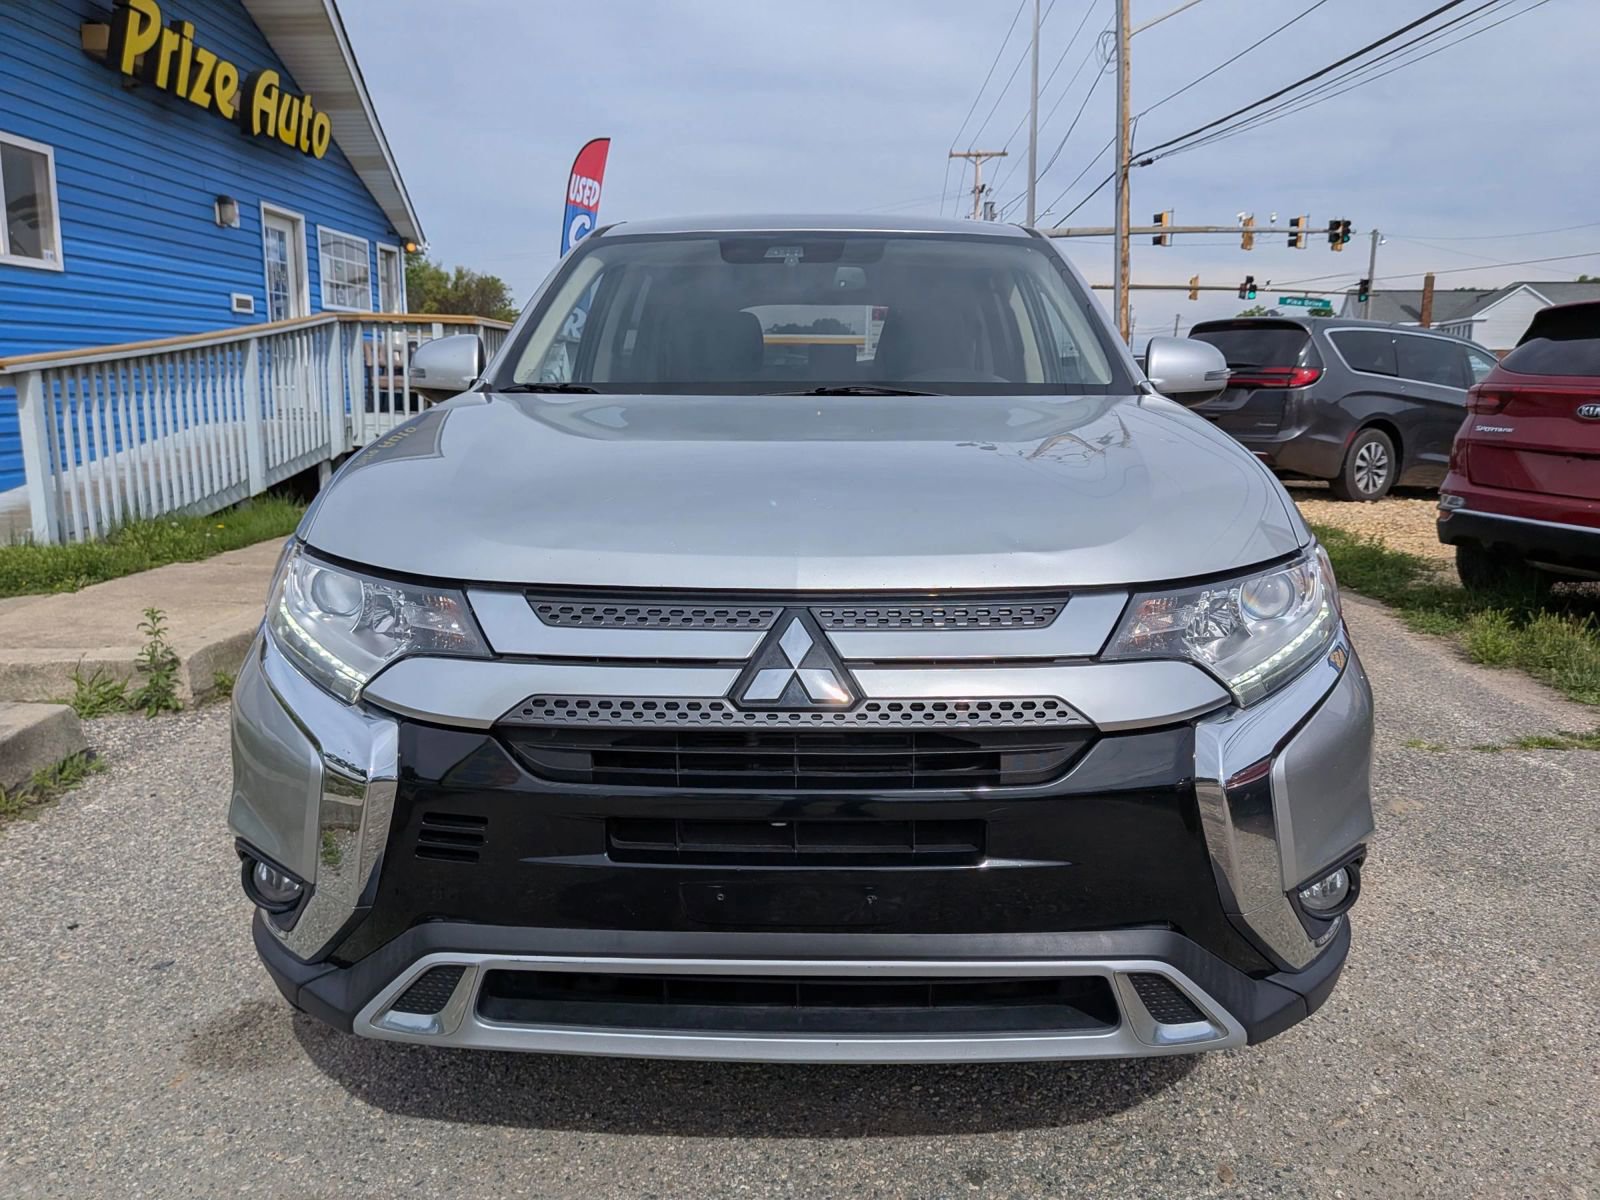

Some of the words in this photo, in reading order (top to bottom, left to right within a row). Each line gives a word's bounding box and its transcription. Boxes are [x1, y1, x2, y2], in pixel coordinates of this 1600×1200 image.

[121, 0, 239, 119] Prize
[252, 69, 332, 160] Auto
[569, 173, 600, 207] USED
